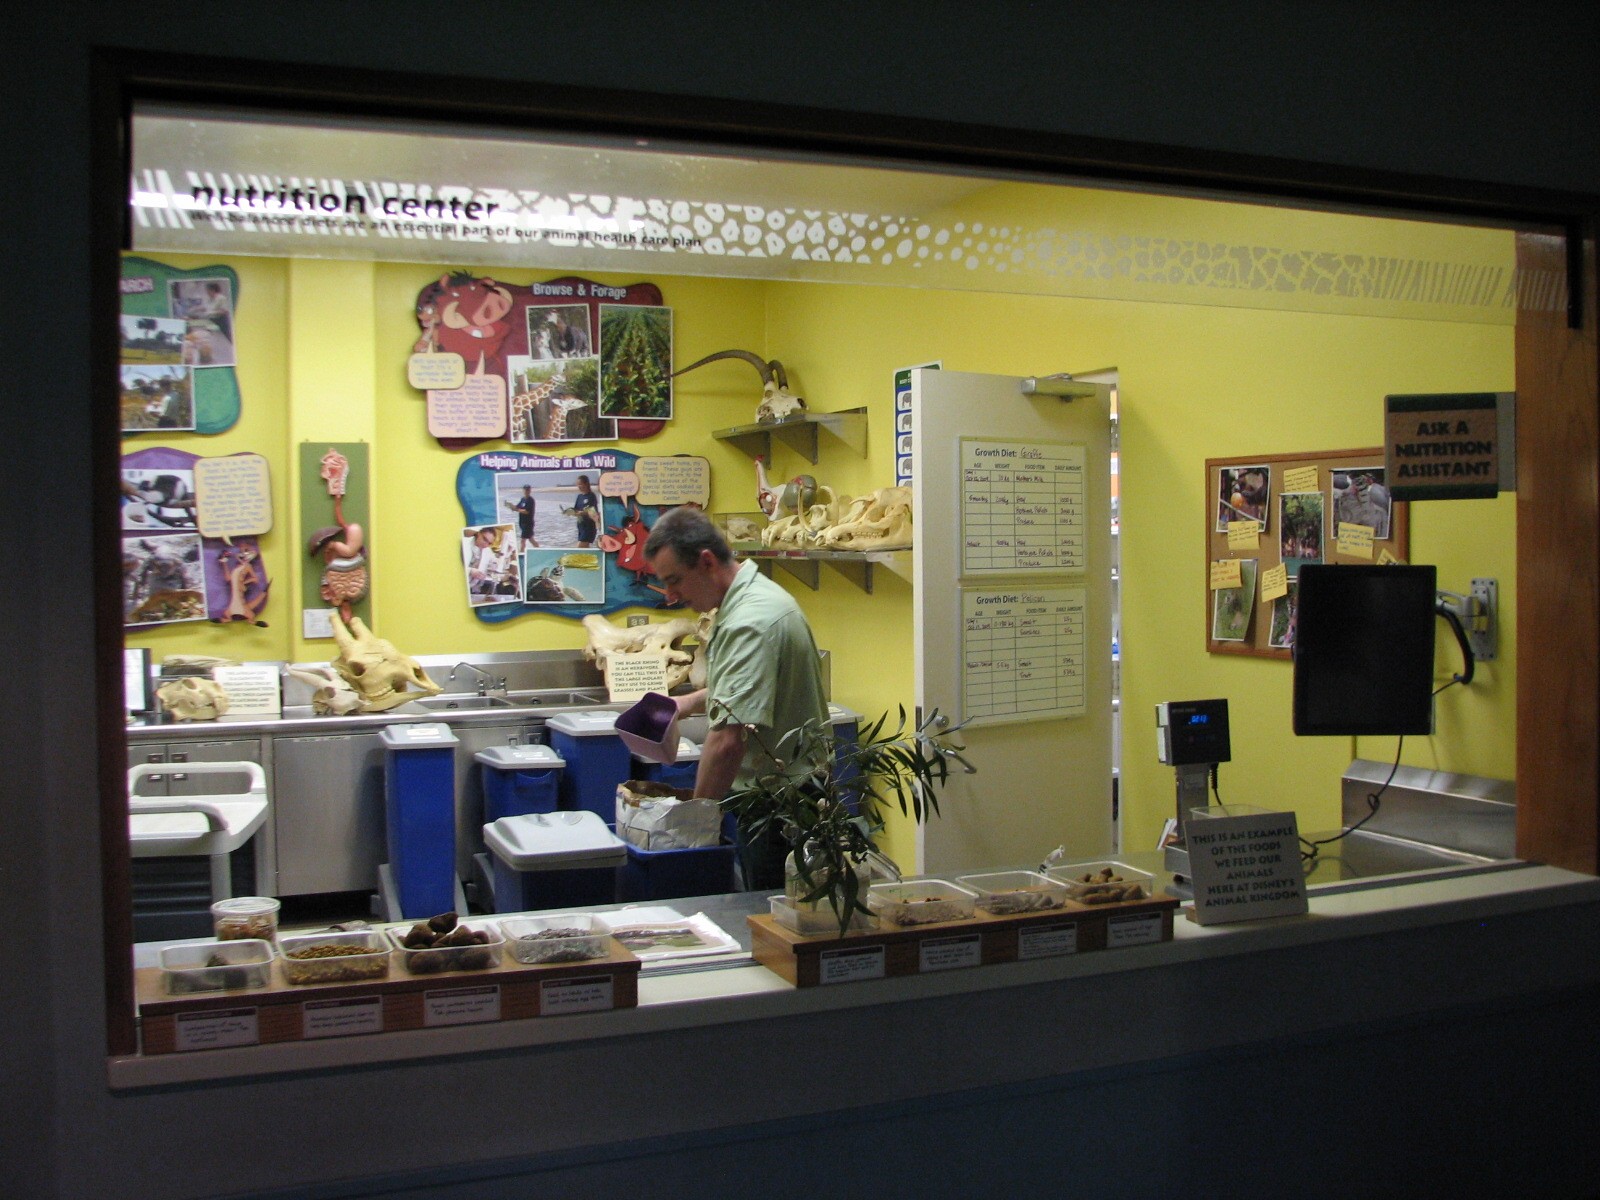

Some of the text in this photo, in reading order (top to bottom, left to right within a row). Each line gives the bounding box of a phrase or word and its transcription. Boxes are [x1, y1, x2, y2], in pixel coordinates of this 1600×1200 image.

[193, 183, 499, 220] nutrition center
[344, 219, 365, 229] are
[370, 220, 388, 230] an
[394, 221, 457, 236] essential
[462, 225, 492, 237] part
[496, 224, 510, 236] of
[514, 228, 537, 239] our
[543, 229, 589, 241] animal
[593, 231, 637, 244] health
[642, 234, 668, 245] care
[672, 236, 701, 248] plan
[533, 282, 627, 299] Browse & Forage
[1417, 421, 1469, 436] ASK A
[975, 448, 1017, 457] Growth Diet:
[1395, 441, 1492, 457] NUTRITION
[480, 454, 616, 470] Helping Animals in the Wild
[1398, 461, 1491, 477] ASSISTANT
[976, 595, 1018, 604] Growth Diet:
[1192, 826, 1294, 845] THIS IS AN EXAMPLE
[1211, 846, 1225, 856] OF
[1225, 844, 1246, 853] THE
[1215, 854, 1282, 869] WE FEED OUR
[1227, 868, 1274, 880] ANIMALS
[1207, 878, 1295, 895] HERE AT DISNEY'S
[1205, 895, 1248, 907] ANIMAL
